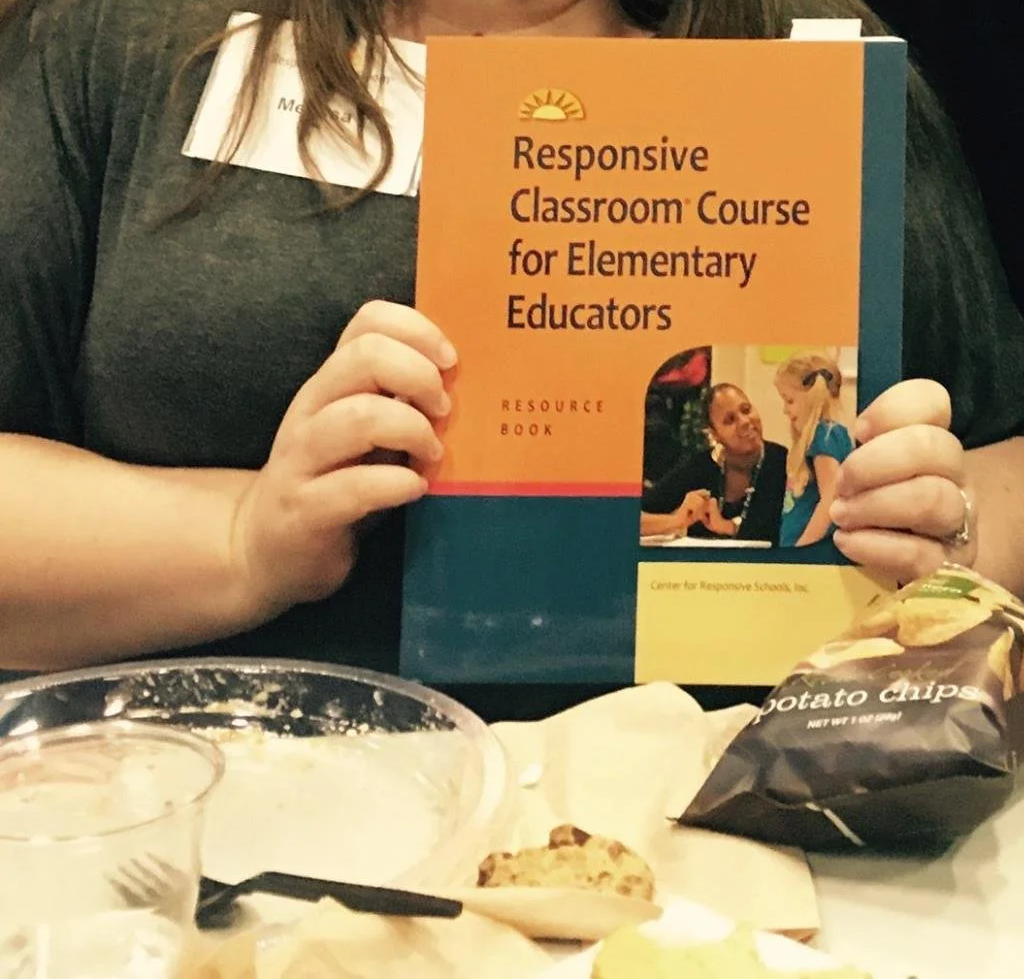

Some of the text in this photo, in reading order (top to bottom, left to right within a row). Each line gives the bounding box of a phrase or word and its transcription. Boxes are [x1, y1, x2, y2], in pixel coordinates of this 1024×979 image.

[512, 135, 709, 181] Responsive
[697, 190, 810, 226] Course
[508, 238, 757, 289] for Elementary
[507, 292, 672, 331] Educators
[501, 398, 604, 413] RESOURCE
[500, 422, 552, 436] BOOK
[650, 580, 682, 591] Center
[683, 579, 698, 591] for
[699, 580, 752, 593] Responsive
[752, 677, 981, 726] potato chips
[806, 718, 830, 730] NET
[831, 716, 849, 726] WT
